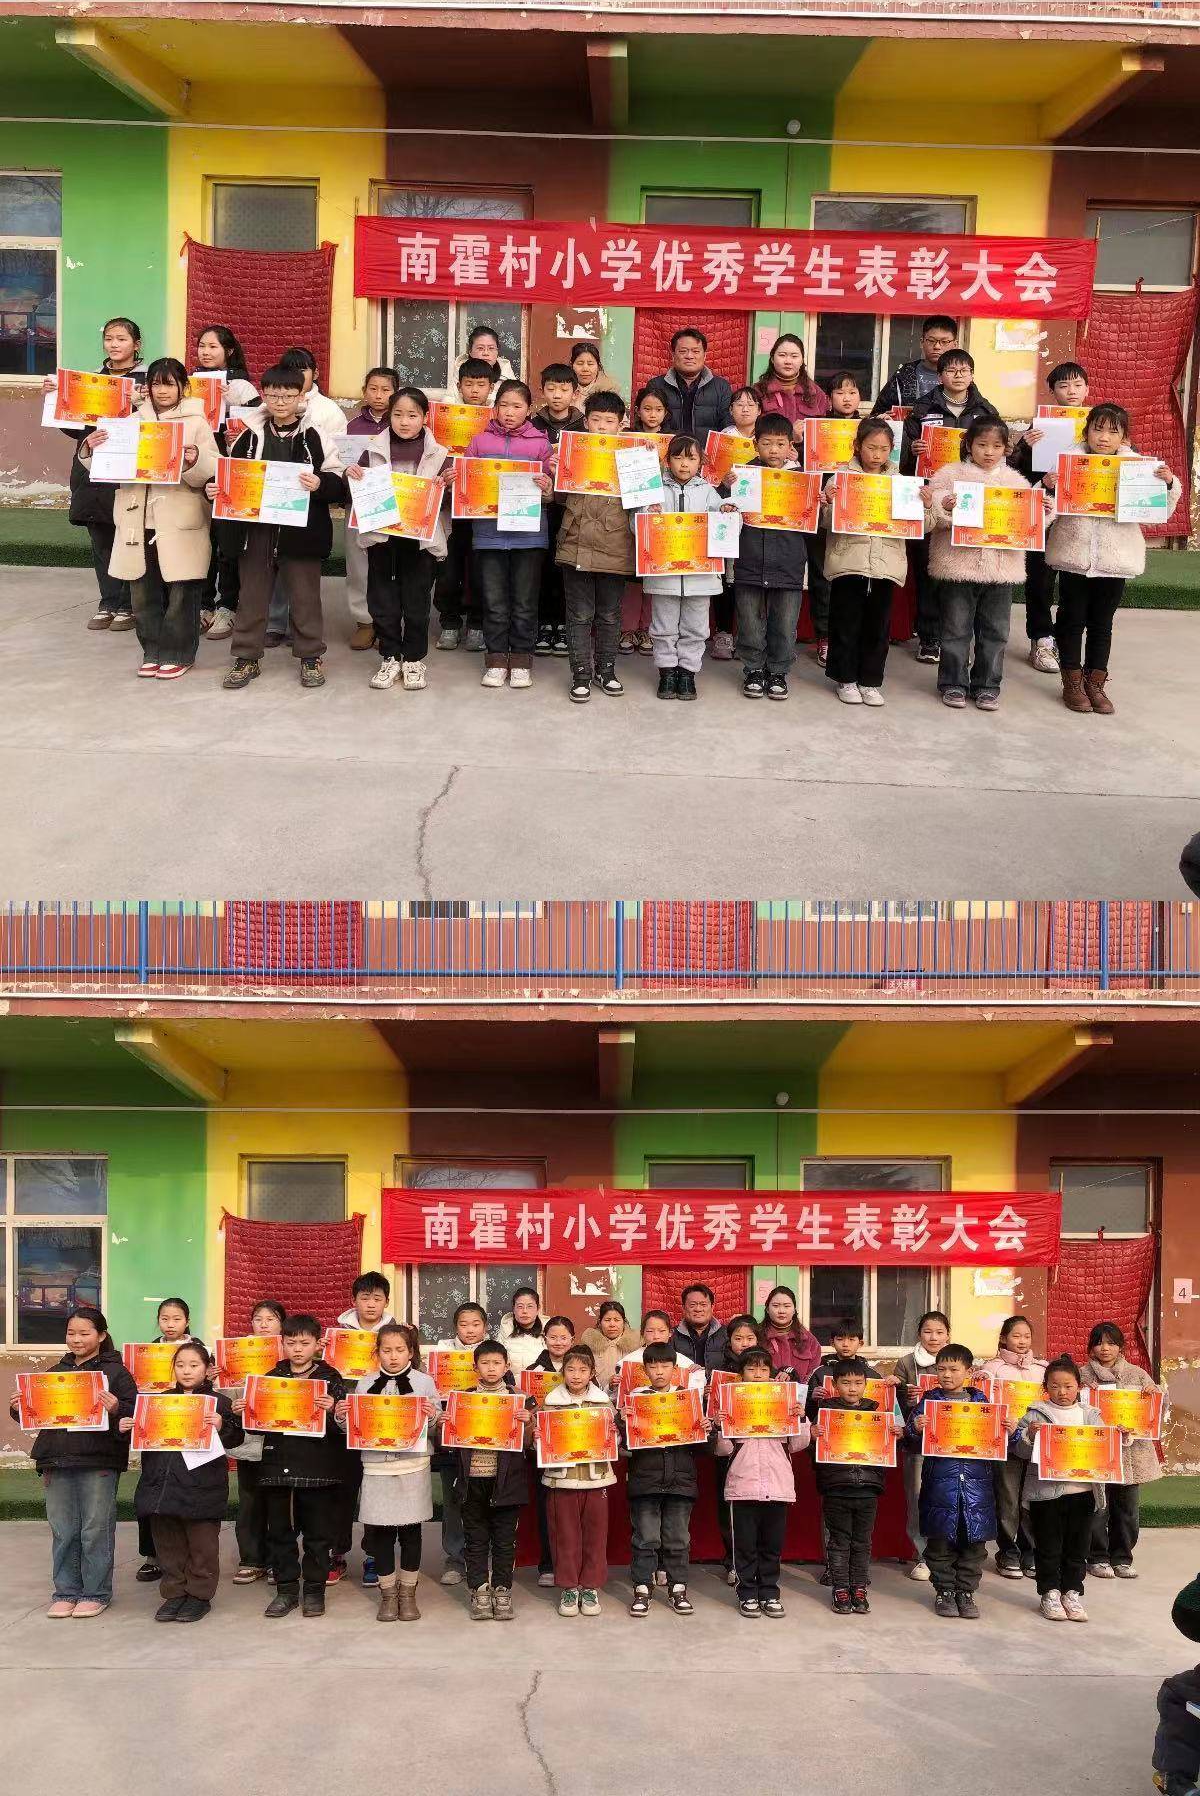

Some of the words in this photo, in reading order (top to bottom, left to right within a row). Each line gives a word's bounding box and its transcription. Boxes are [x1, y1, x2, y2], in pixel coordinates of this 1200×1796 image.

[397, 232, 1058, 303] 南霍村小学优秀学生表彰大会
[421, 1202, 1027, 1253] 南霍村小学优秀学生表彰大会
[1178, 1287, 1187, 1299] 4
